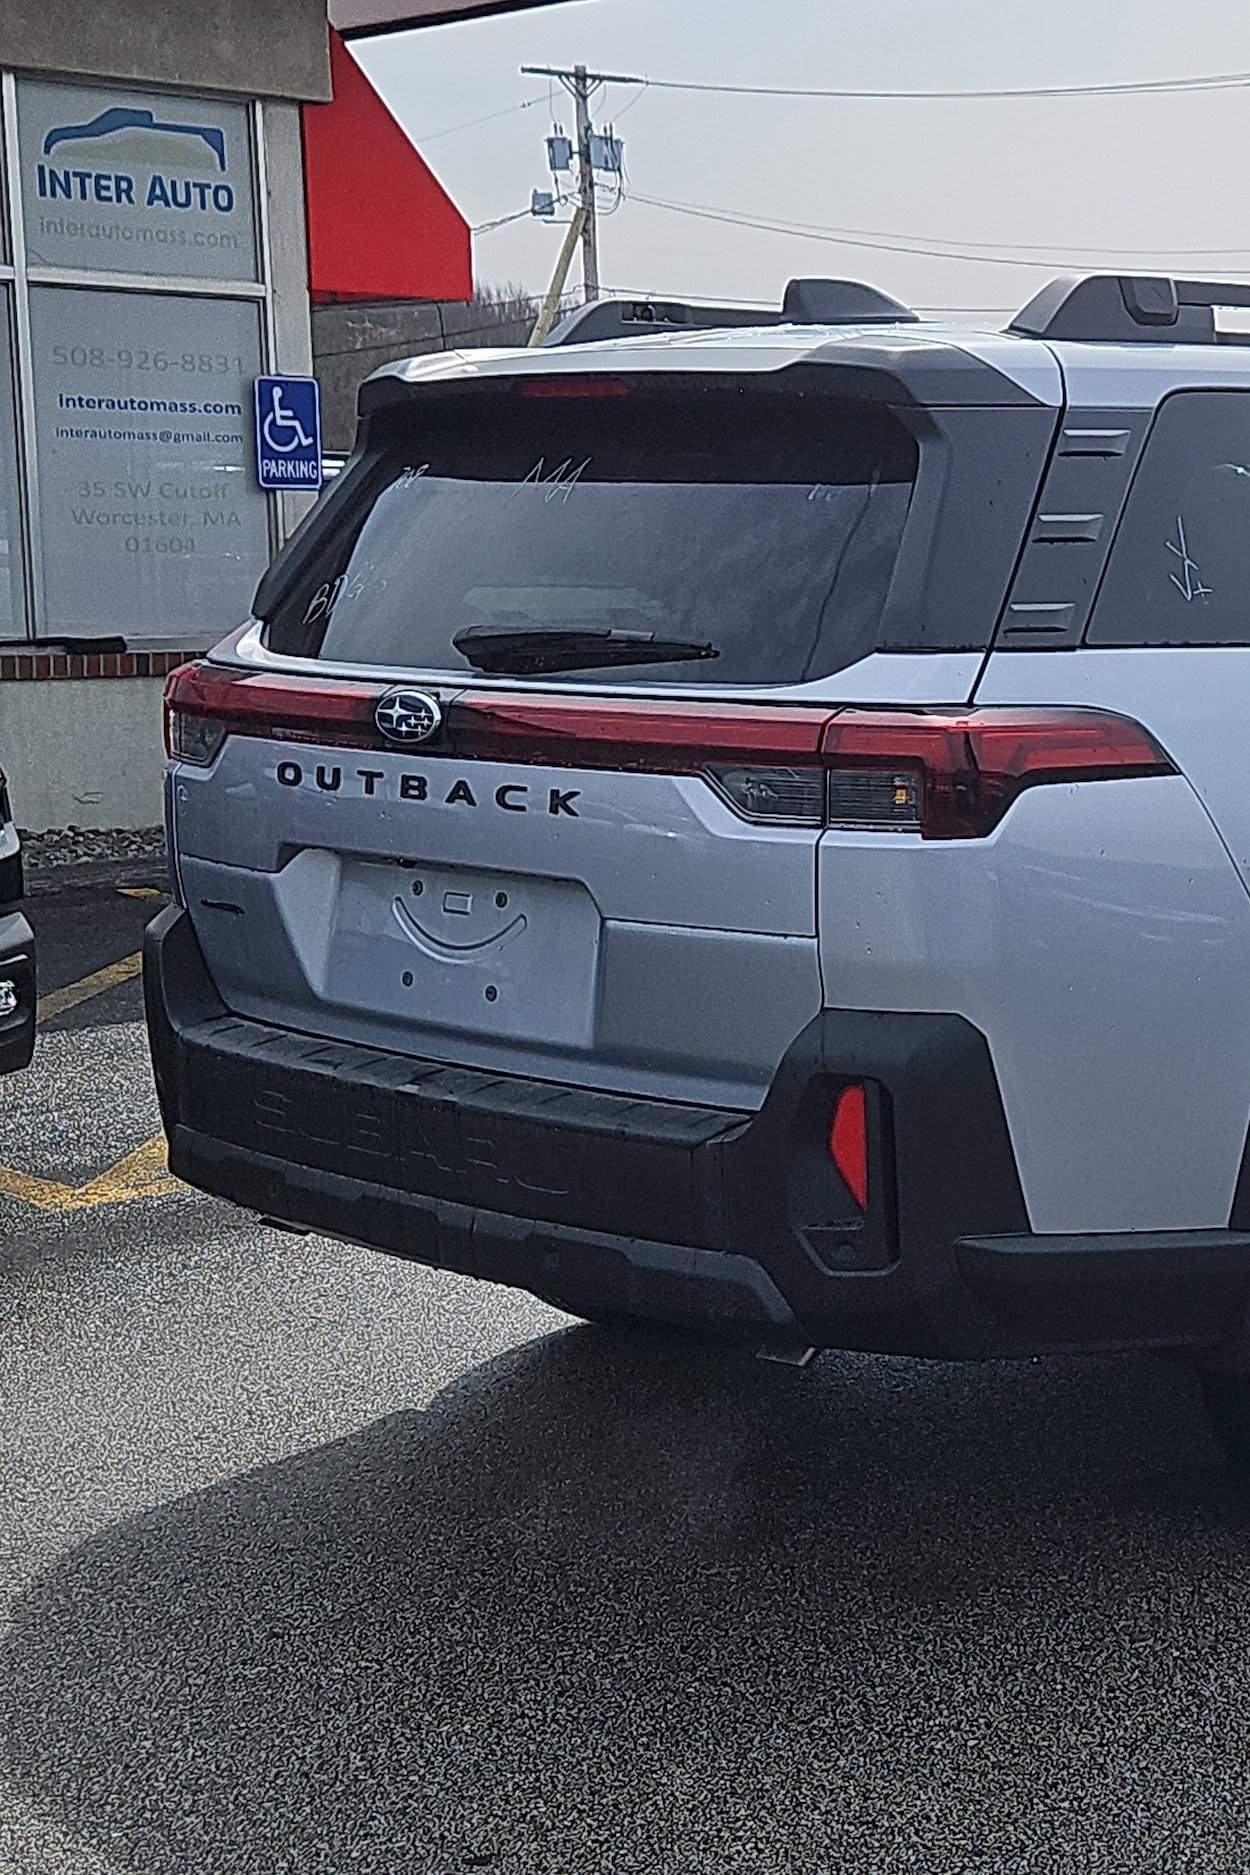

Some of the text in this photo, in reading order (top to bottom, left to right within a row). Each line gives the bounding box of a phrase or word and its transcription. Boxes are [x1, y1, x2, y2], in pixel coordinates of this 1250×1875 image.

[37, 164, 234, 213] INTER AUTO
[39, 215, 239, 249] interautomass.com
[53, 346, 246, 374] 508-926-8831
[262, 459, 318, 479] PARKING
[79, 481, 228, 499] 35 SW Cutoff
[203, 511, 242, 528] MA
[125, 537, 196, 553] 01604
[276, 761, 581, 818] OUTBACK
